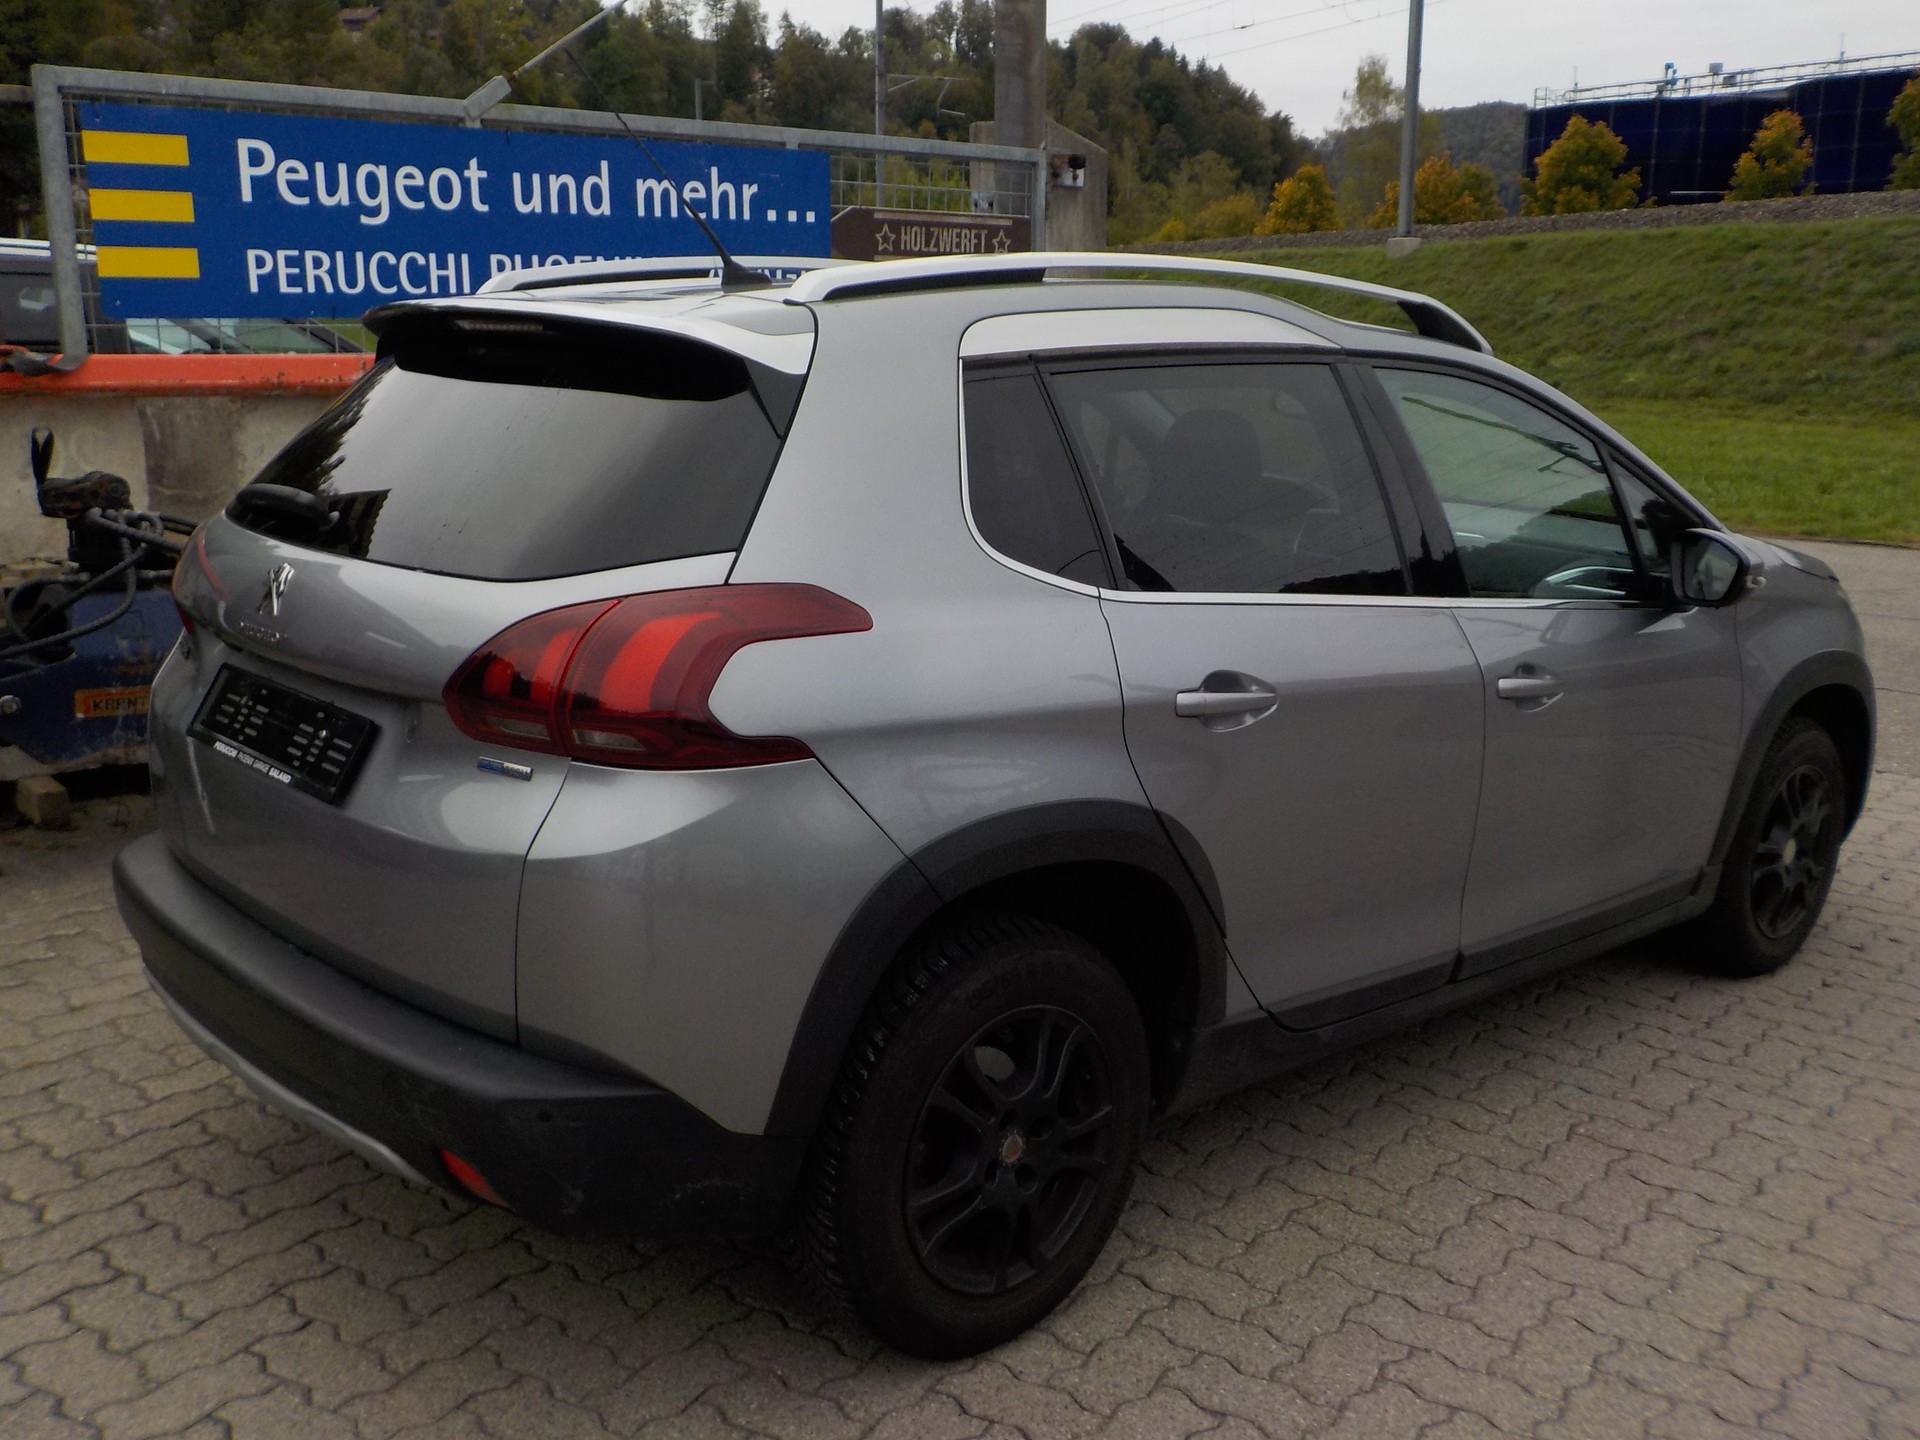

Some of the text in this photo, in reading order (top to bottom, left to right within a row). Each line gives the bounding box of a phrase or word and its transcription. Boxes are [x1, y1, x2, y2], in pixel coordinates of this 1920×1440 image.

[237, 138, 816, 225] Peugeot und mehr...
[900, 225, 988, 253] HOLZWERFT
[246, 248, 471, 294] PERUCCHI
